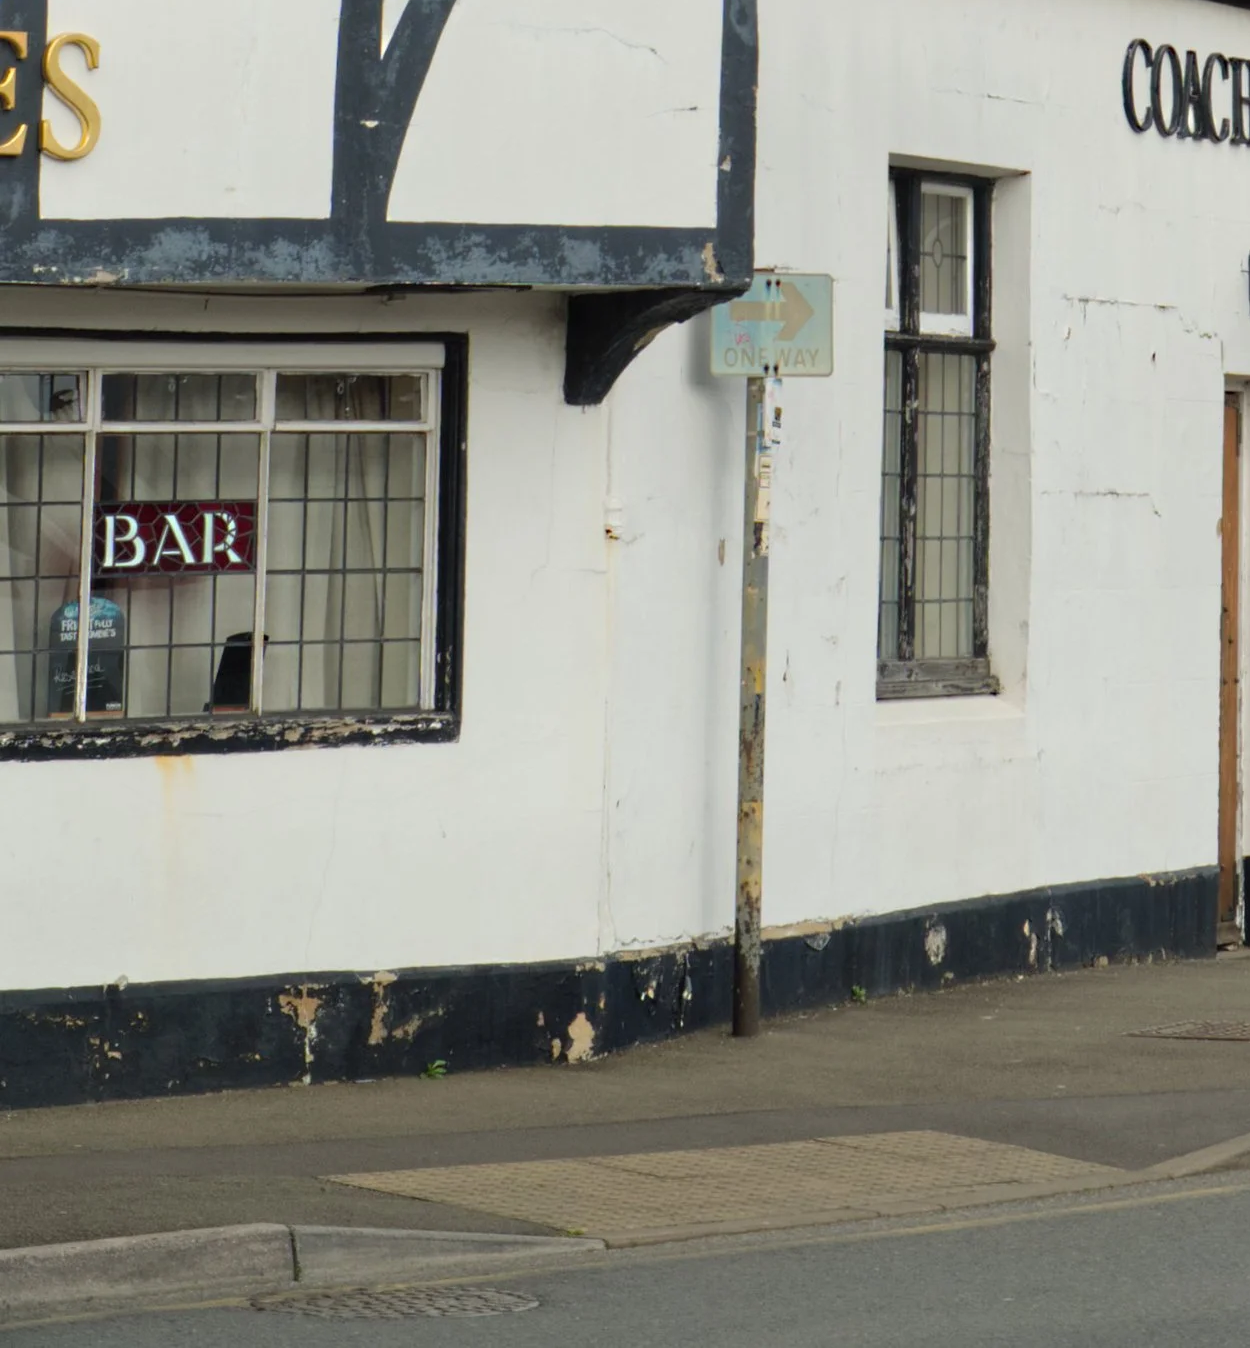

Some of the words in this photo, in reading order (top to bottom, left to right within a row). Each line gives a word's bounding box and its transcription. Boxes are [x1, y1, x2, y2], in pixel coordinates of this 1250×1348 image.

[724, 347, 769, 368] ONE
[774, 347, 820, 368] WAY
[103, 511, 242, 568] BAR
